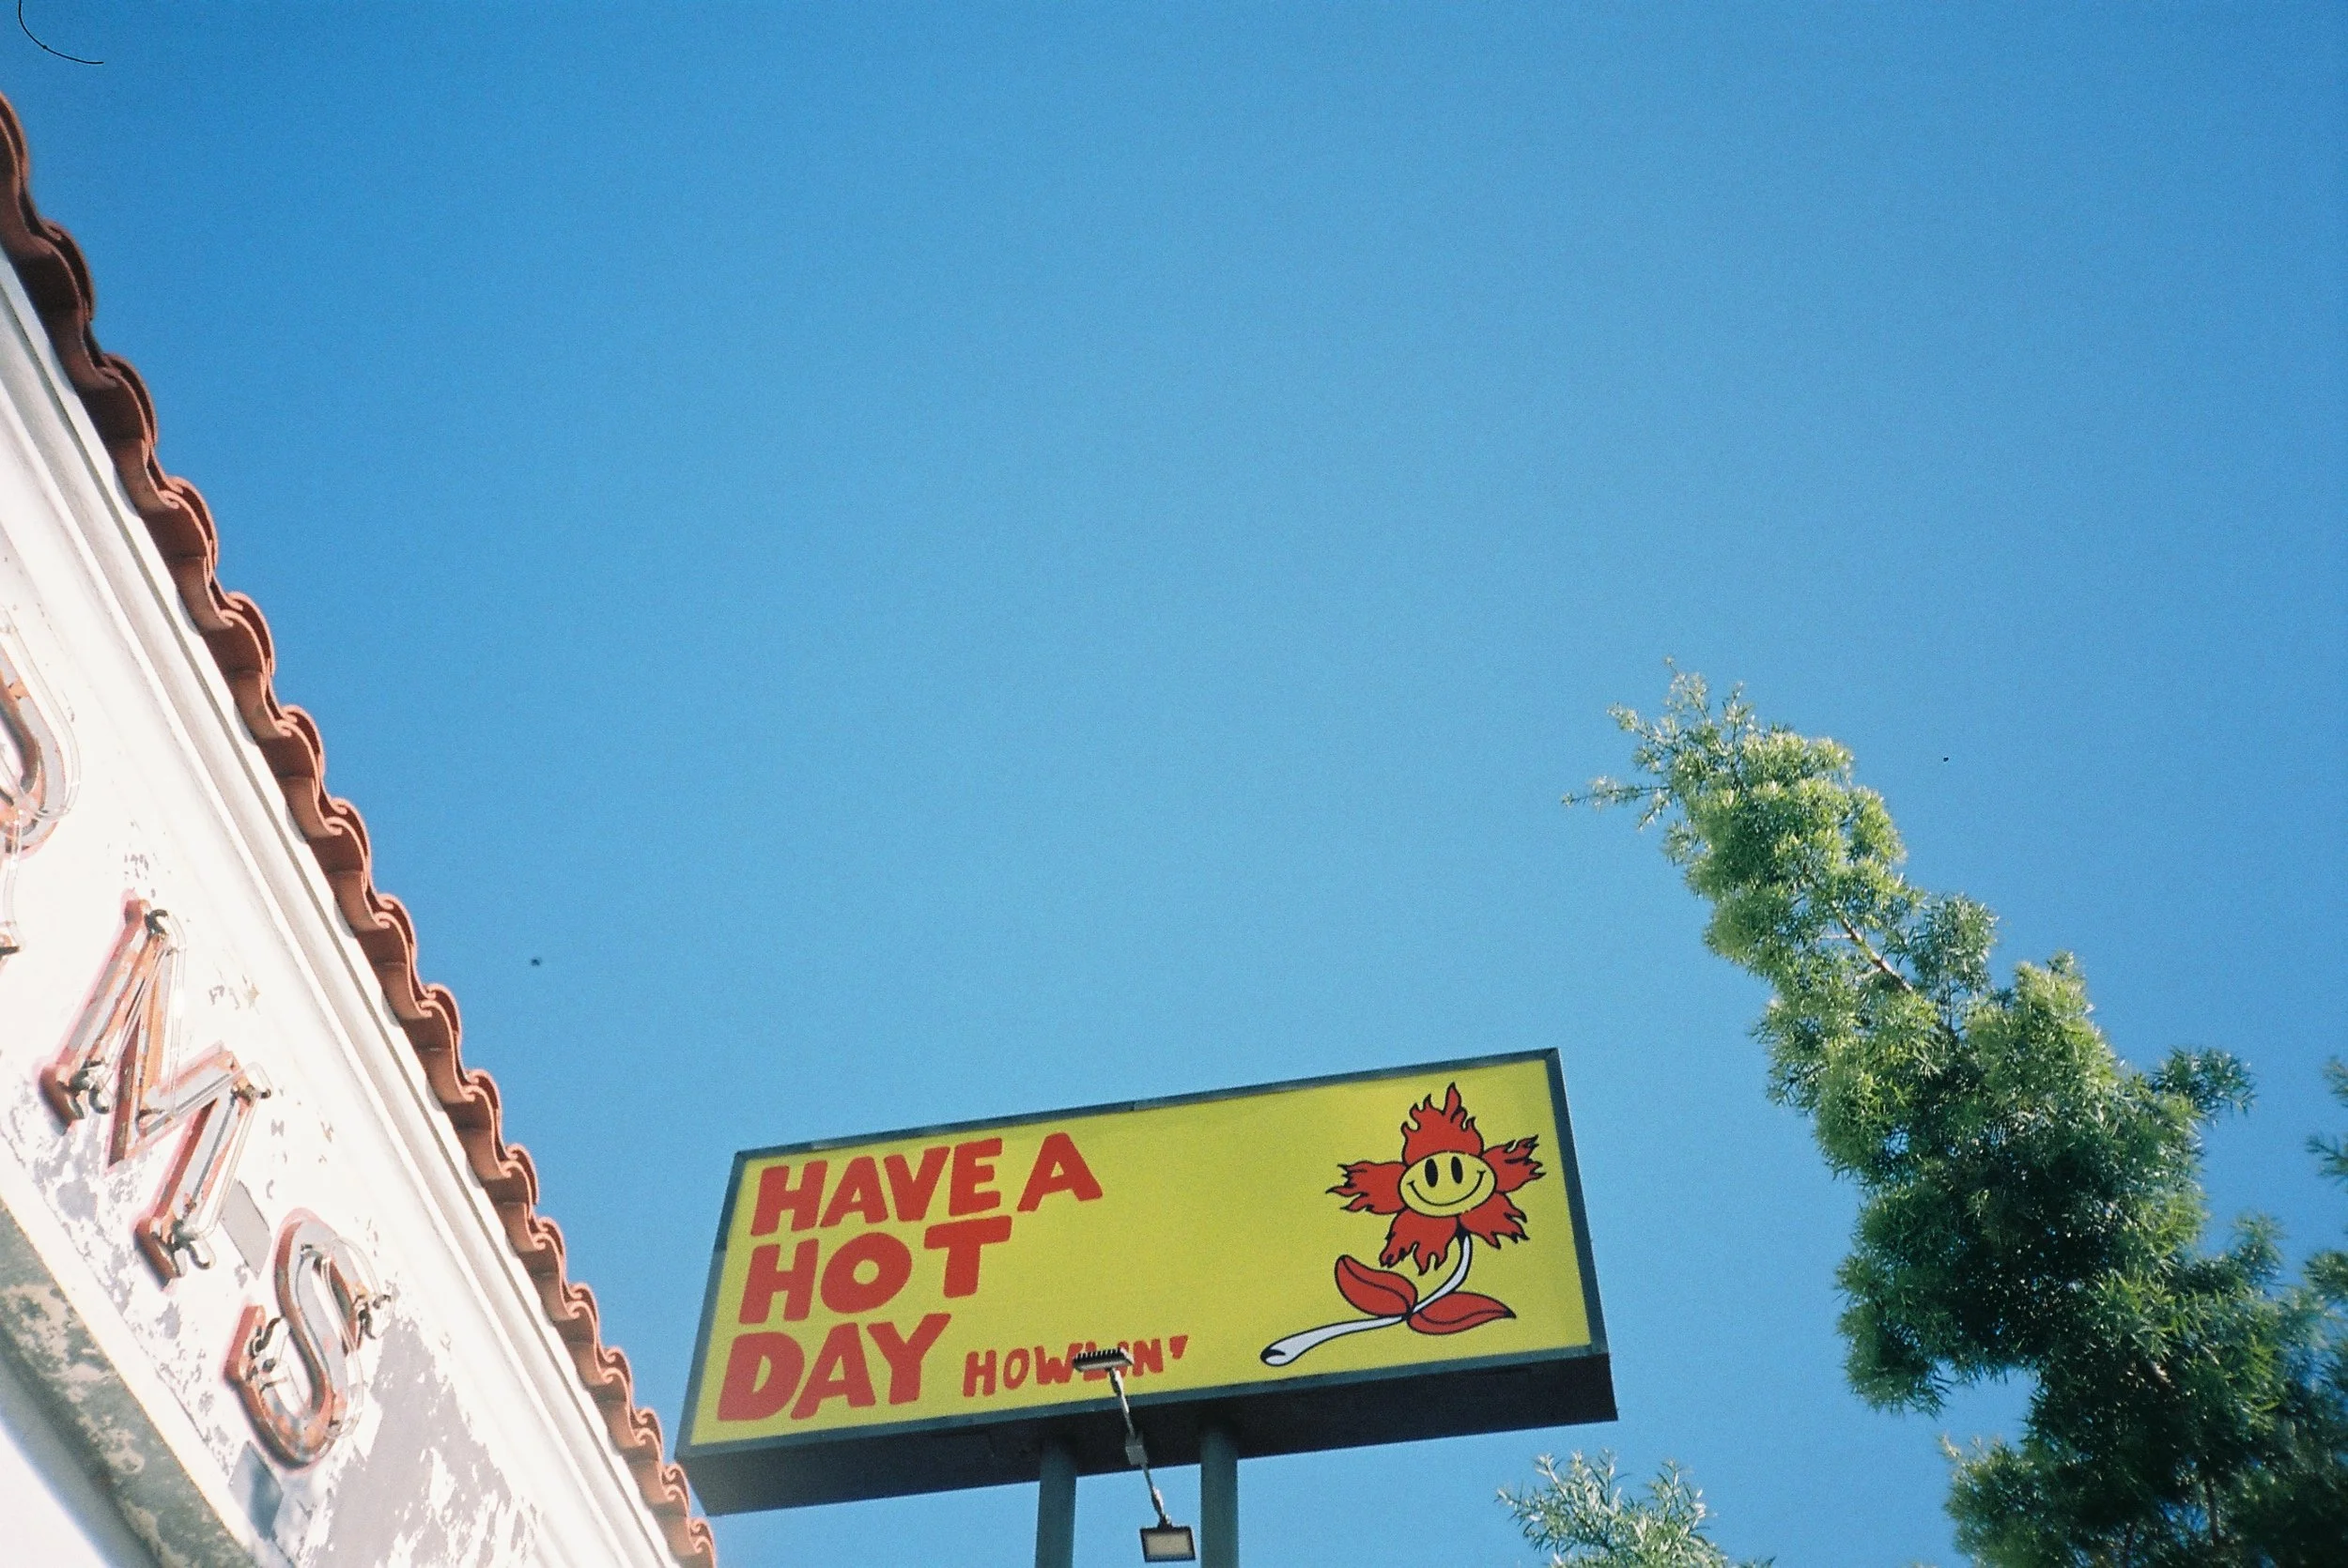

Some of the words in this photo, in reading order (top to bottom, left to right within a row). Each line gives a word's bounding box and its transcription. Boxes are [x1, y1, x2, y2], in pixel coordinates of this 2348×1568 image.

[750, 1138, 1004, 1237] HAVE
[1017, 1132, 1103, 1213] A
[739, 1215, 1012, 1325] HOT
[718, 1313, 952, 1421] DAY
